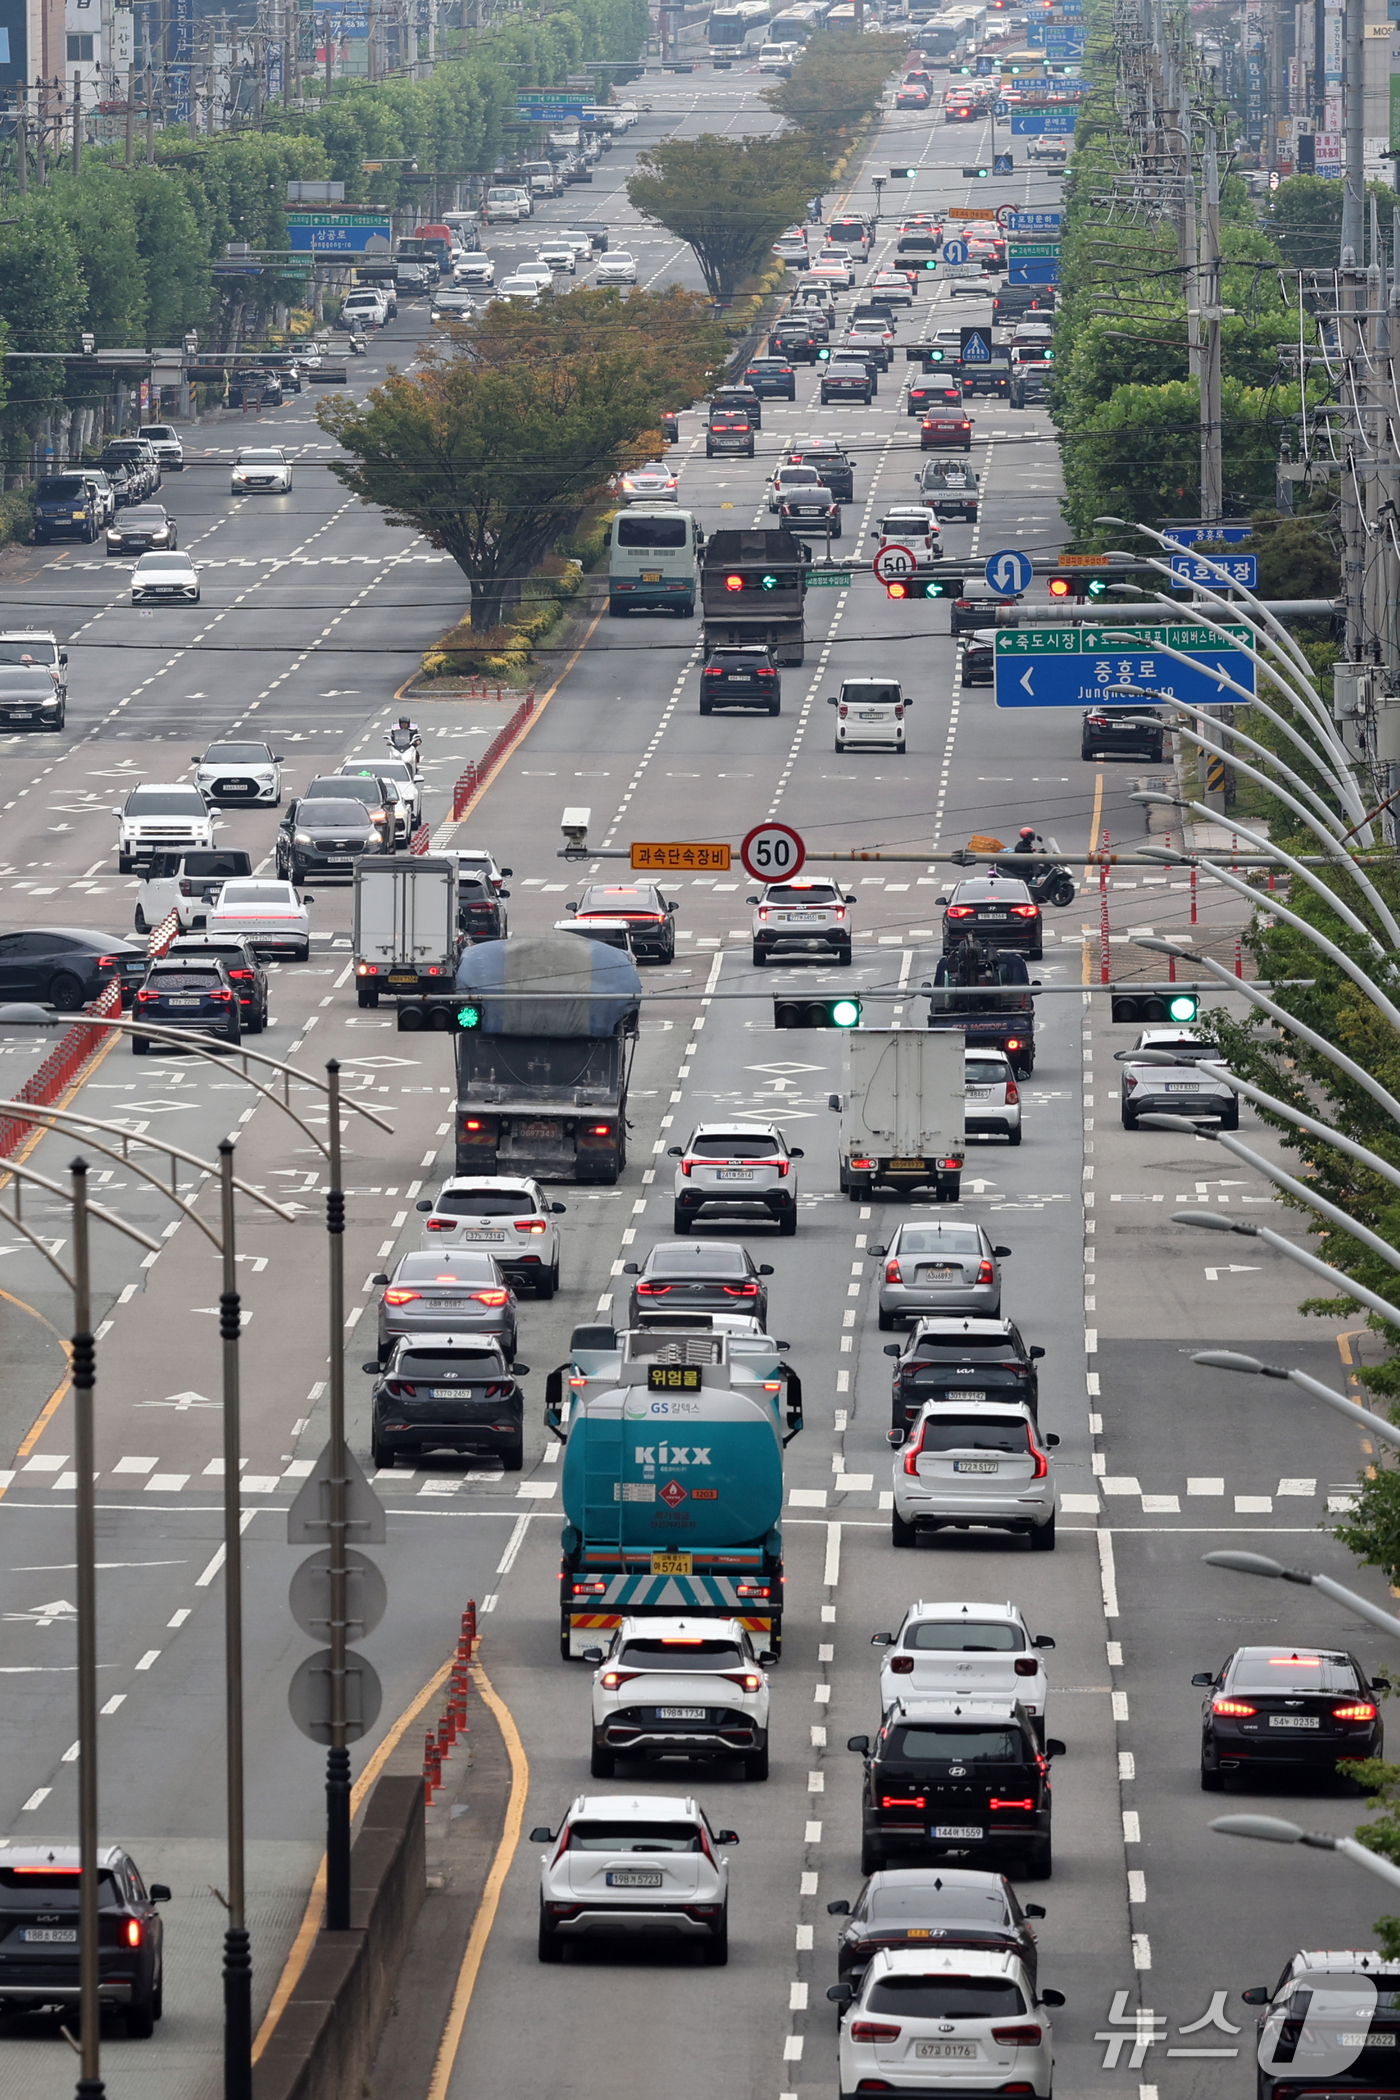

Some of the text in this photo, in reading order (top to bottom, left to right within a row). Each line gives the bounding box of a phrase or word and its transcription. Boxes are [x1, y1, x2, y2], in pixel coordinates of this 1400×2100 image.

[317, 229, 346, 240] 상공로
[1196, 530, 1225, 540] 중흥로
[884, 556, 907, 573] 50
[1015, 633, 1076, 650] 죽도시장
[1093, 660, 1157, 684] 중흥로
[639, 849, 724, 866] 과속단속장비
[756, 839, 790, 867] 50
[652, 1369, 698, 1387] 위험물
[453, 1390, 470, 1398] 2457
[968, 1392, 985, 1400] 9142
[650, 1402, 701, 1414] GS 칼텍스
[979, 1463, 997, 1472] 5177
[696, 1490, 714, 1498] 1203
[662, 1561, 688, 1573] 5741
[684, 1709, 704, 1718] 1734
[1293, 1717, 1316, 1727] 0235
[961, 1828, 982, 1838] 1559
[637, 1874, 660, 1886] 5723
[52, 1930, 75, 1942] 8255
[1369, 2034, 1394, 2046] 2622
[944, 2044, 971, 2055] 0176
